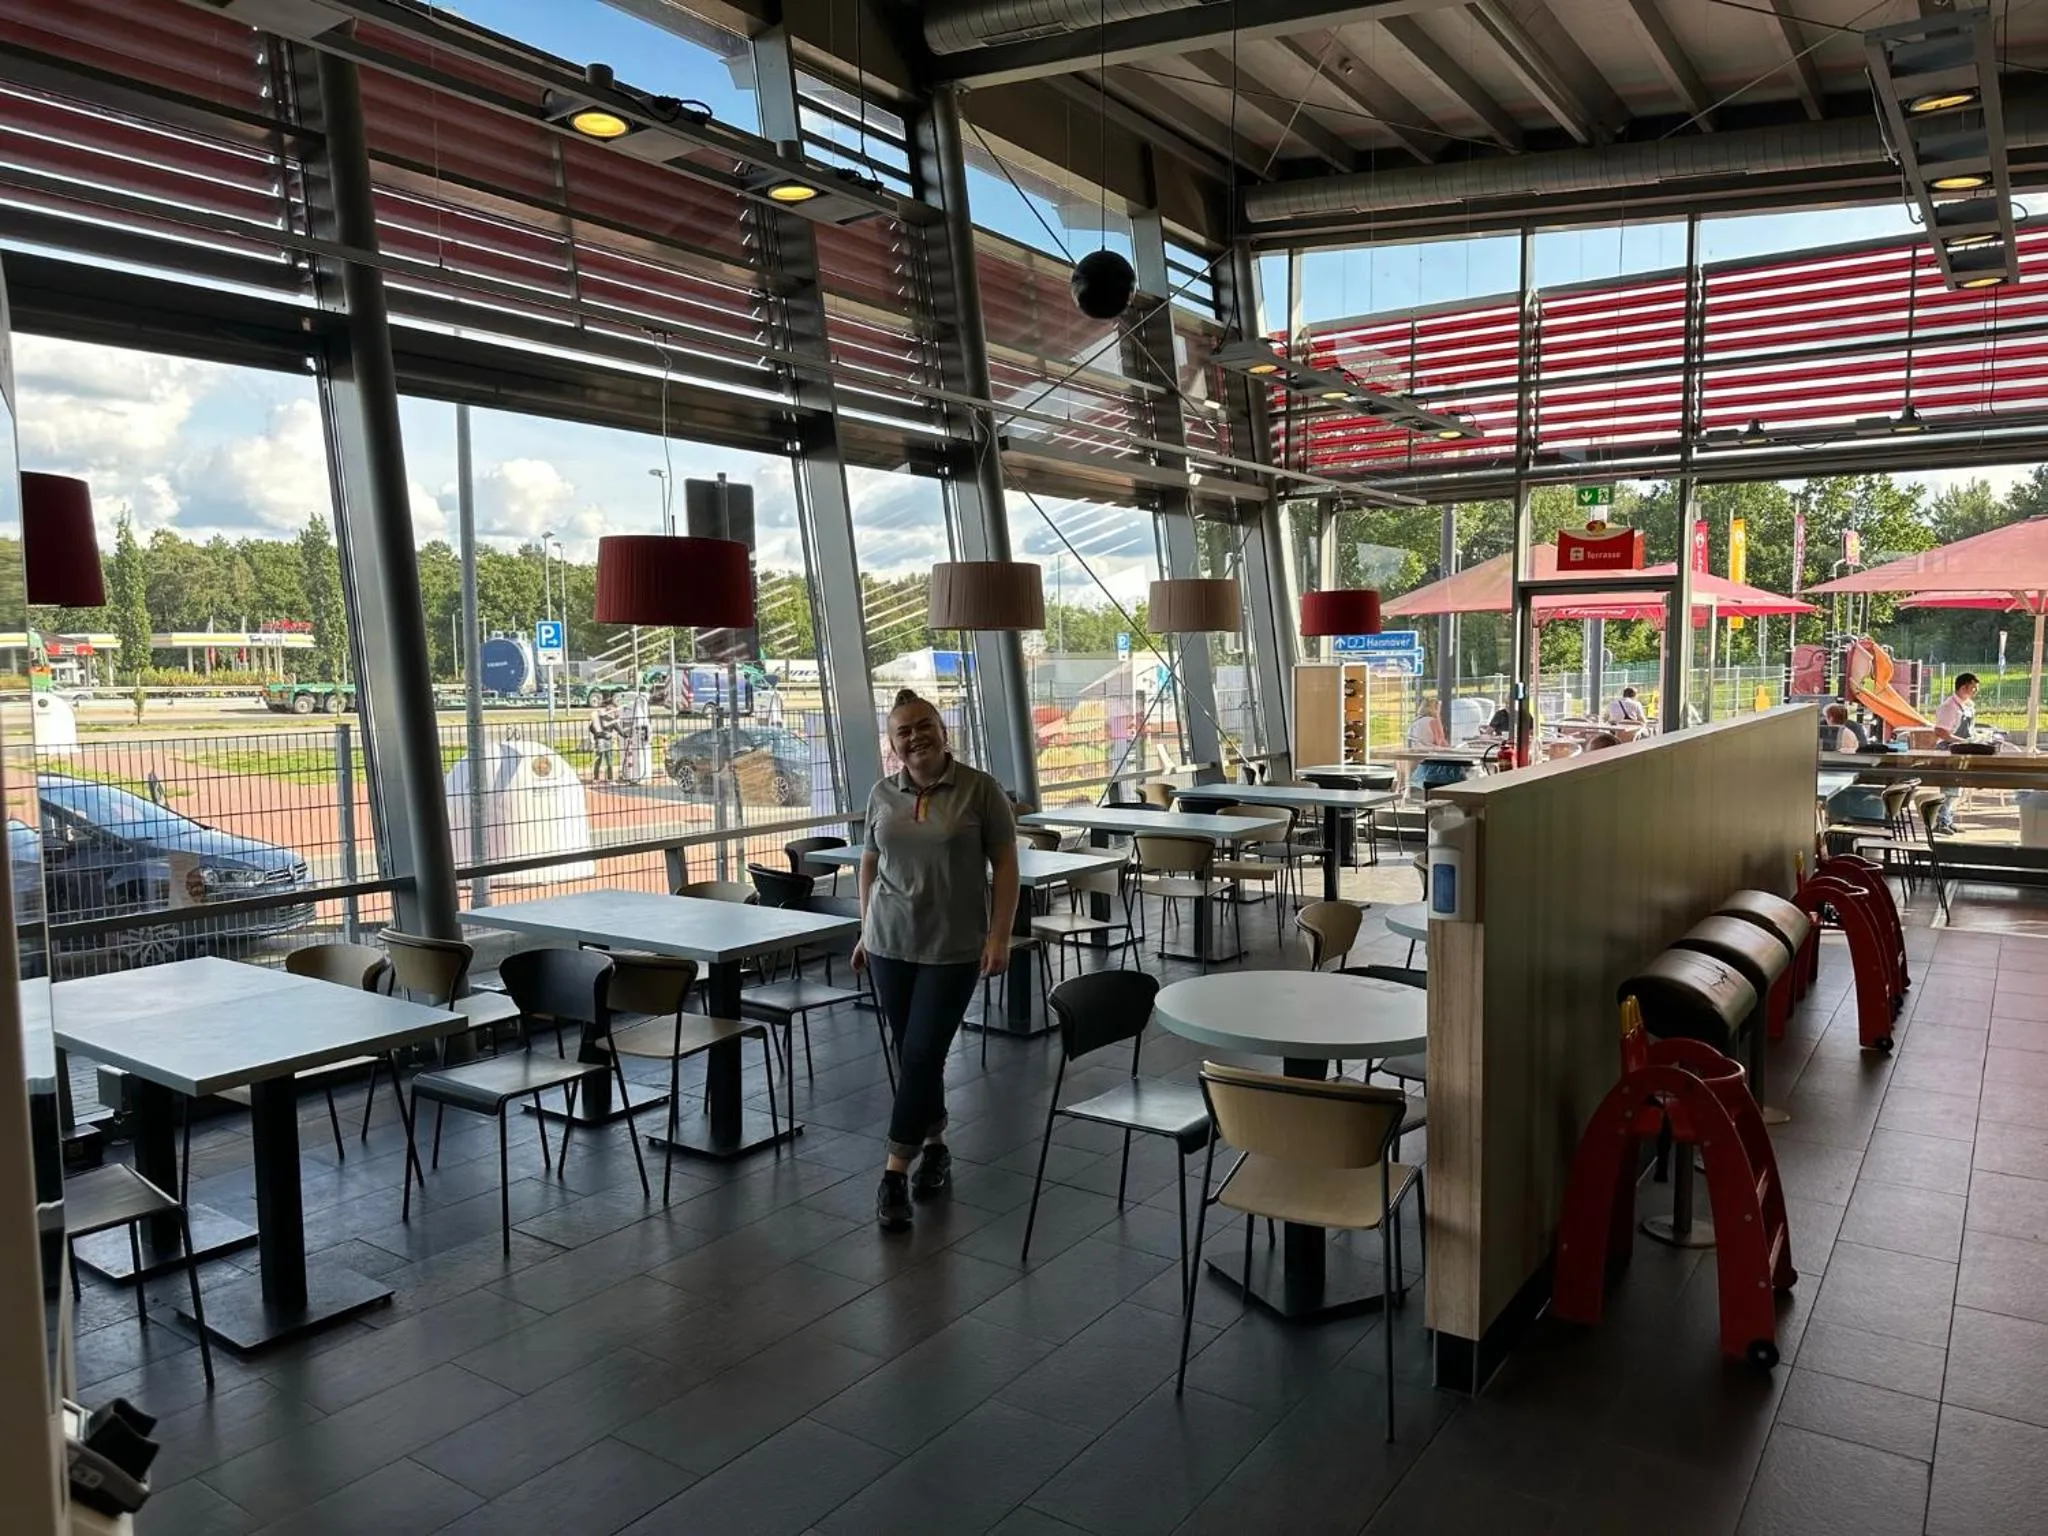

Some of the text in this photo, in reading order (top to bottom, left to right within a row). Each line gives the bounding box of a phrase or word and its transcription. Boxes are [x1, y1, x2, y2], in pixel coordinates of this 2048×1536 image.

[1587, 551, 1622, 560] Terrasse
[540, 625, 556, 646] P
[1366, 637, 1411, 647] Hannover
